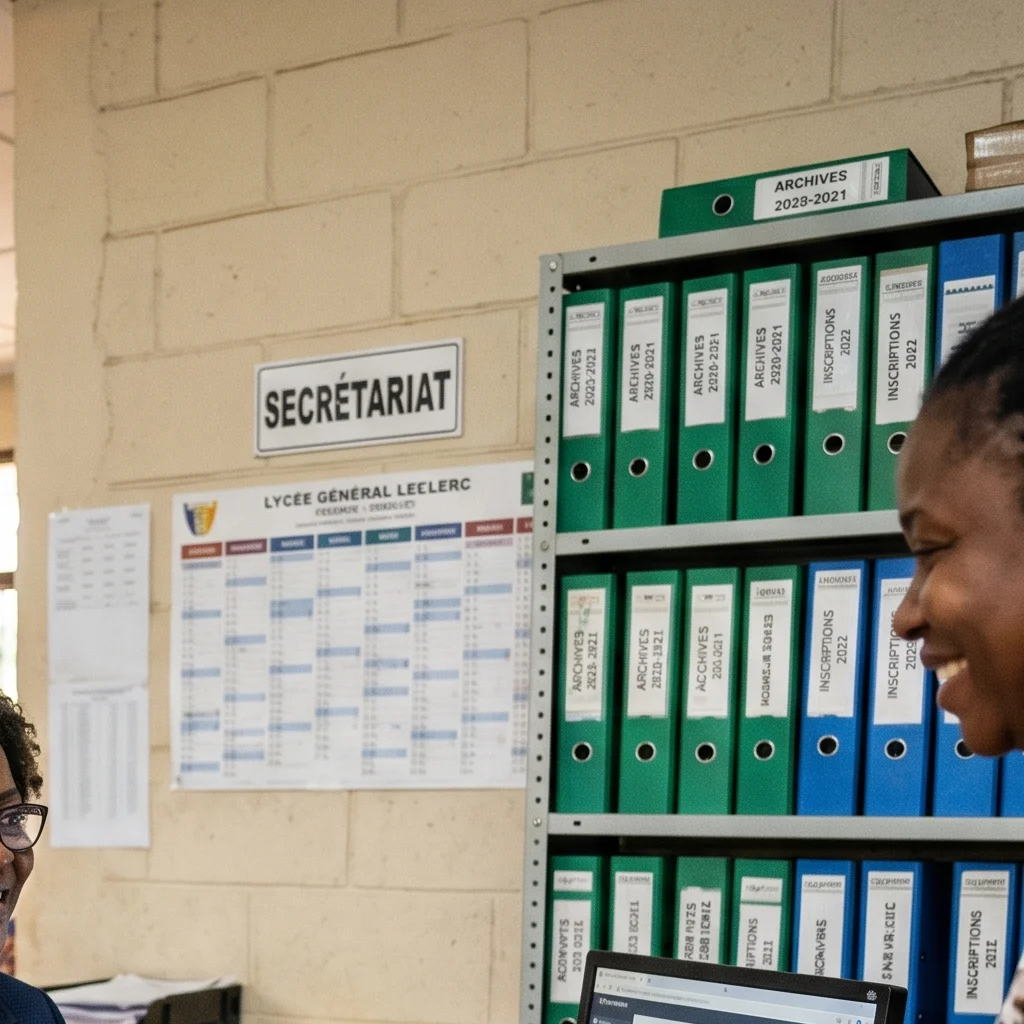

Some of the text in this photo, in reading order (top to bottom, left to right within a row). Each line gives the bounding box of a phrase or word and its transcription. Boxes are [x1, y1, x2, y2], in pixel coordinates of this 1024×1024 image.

[774, 169, 848, 194] ARCHIVES
[693, 335, 705, 396] ARCHIVES
[888, 312, 901, 401] INSCRIPTIONS
[264, 370, 452, 429] SECRÉTARIAT
[265, 493, 313, 509] LYCÉE
[317, 484, 392, 504] GÉNÉRAL
[837, 634, 849, 664] 2022
